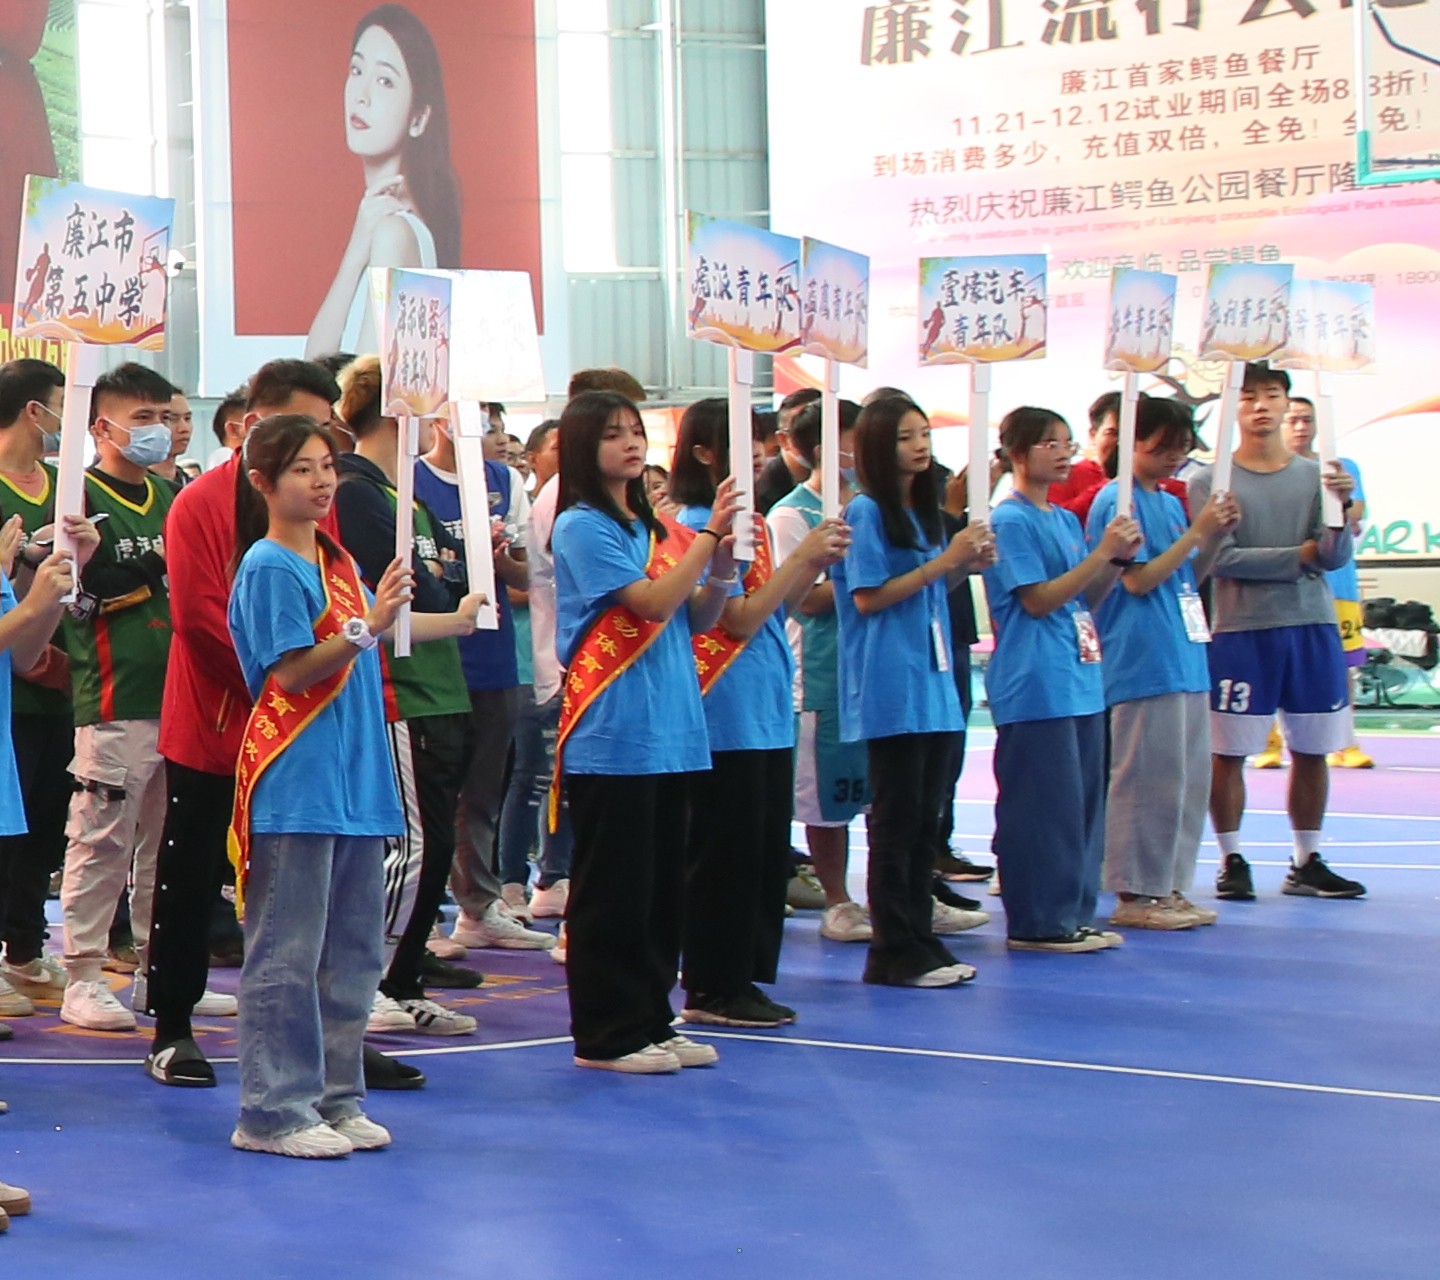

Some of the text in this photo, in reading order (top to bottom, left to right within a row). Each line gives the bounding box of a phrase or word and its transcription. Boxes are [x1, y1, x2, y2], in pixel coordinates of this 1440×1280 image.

[1059, 44, 1321, 96] 廉江首家鳄鱼餐厅
[64, 202, 136, 262] 廉江市
[42, 265, 149, 328] 第五中学
[952, 313, 1014, 350] 青年队
[1340, 619, 1362, 641] 2
[1217, 678, 1251, 713] 13
